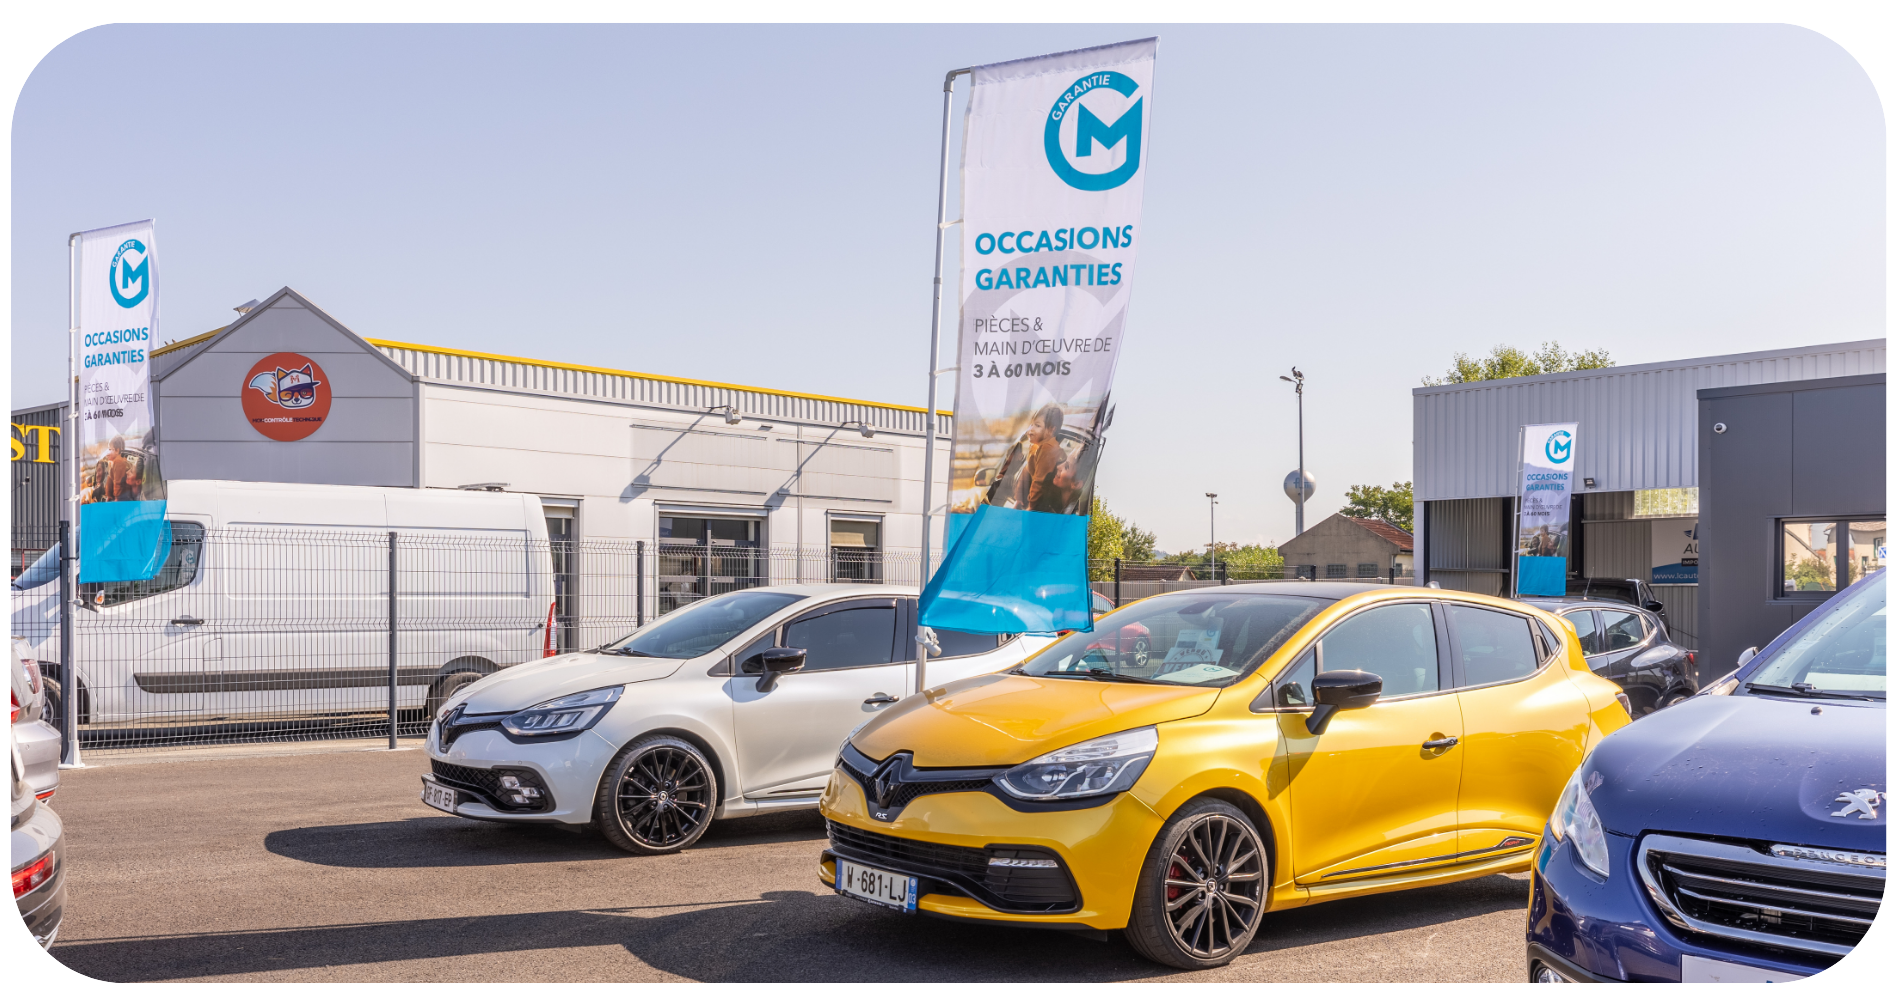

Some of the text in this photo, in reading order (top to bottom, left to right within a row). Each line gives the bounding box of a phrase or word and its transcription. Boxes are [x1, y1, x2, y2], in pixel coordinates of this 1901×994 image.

[1052, 75, 1110, 120] GARANTIE
[975, 224, 1133, 255] OCCASIONS
[975, 262, 1123, 291] GARANTIES
[975, 315, 1043, 333] PIÈCES &
[84, 327, 149, 347] OCCASIONS
[974, 341, 1017, 356] MAIN
[1094, 337, 1112, 352] DE
[84, 349, 144, 369] GARANTIES
[973, 361, 1071, 378] 3 À 60 MOIS
[104, 382, 110, 391] &
[1526, 473, 1568, 481] OCCASIONS
[1525, 483, 1565, 491] GARANTIES
